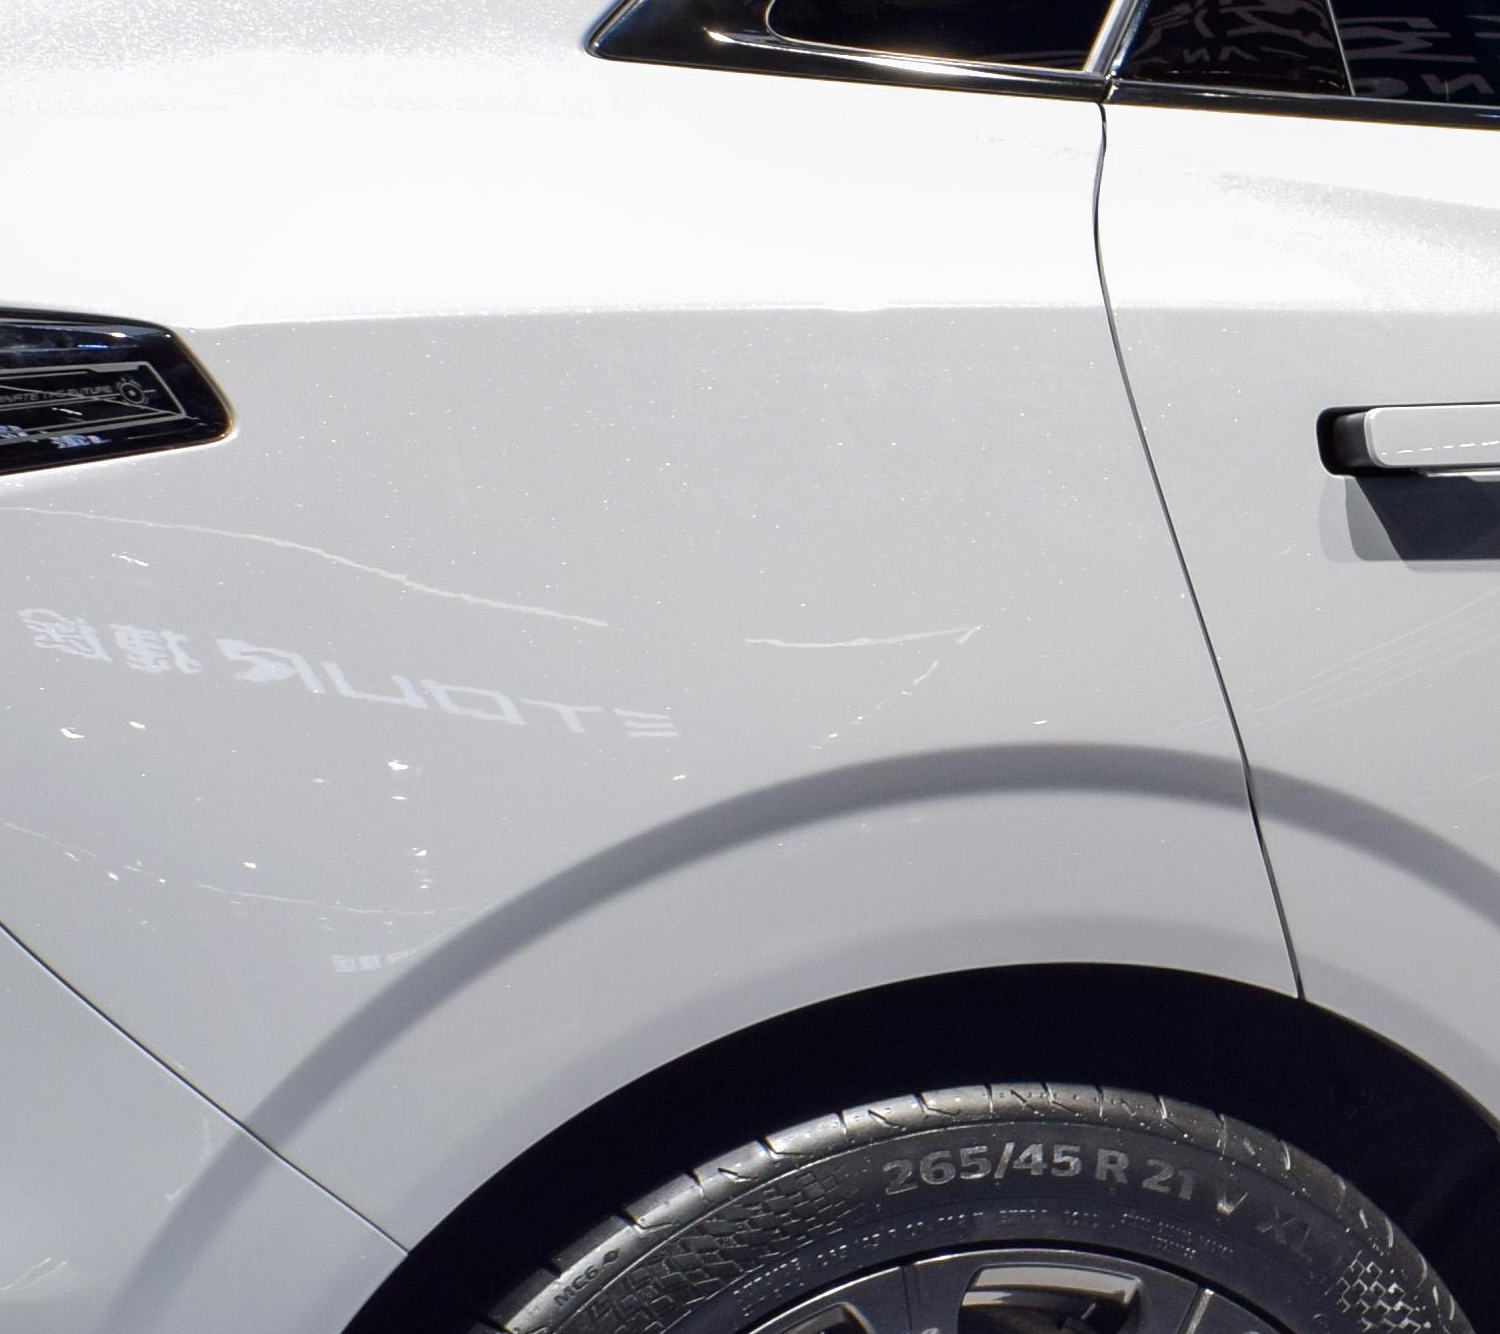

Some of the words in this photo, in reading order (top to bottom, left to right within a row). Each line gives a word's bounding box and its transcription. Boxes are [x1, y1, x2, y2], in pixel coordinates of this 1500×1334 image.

[882, 1141, 1082, 1196] 265/45
[1094, 1147, 1130, 1185] R
[1141, 1158, 1198, 1201] 21
[553, 1264, 600, 1309] MC6
